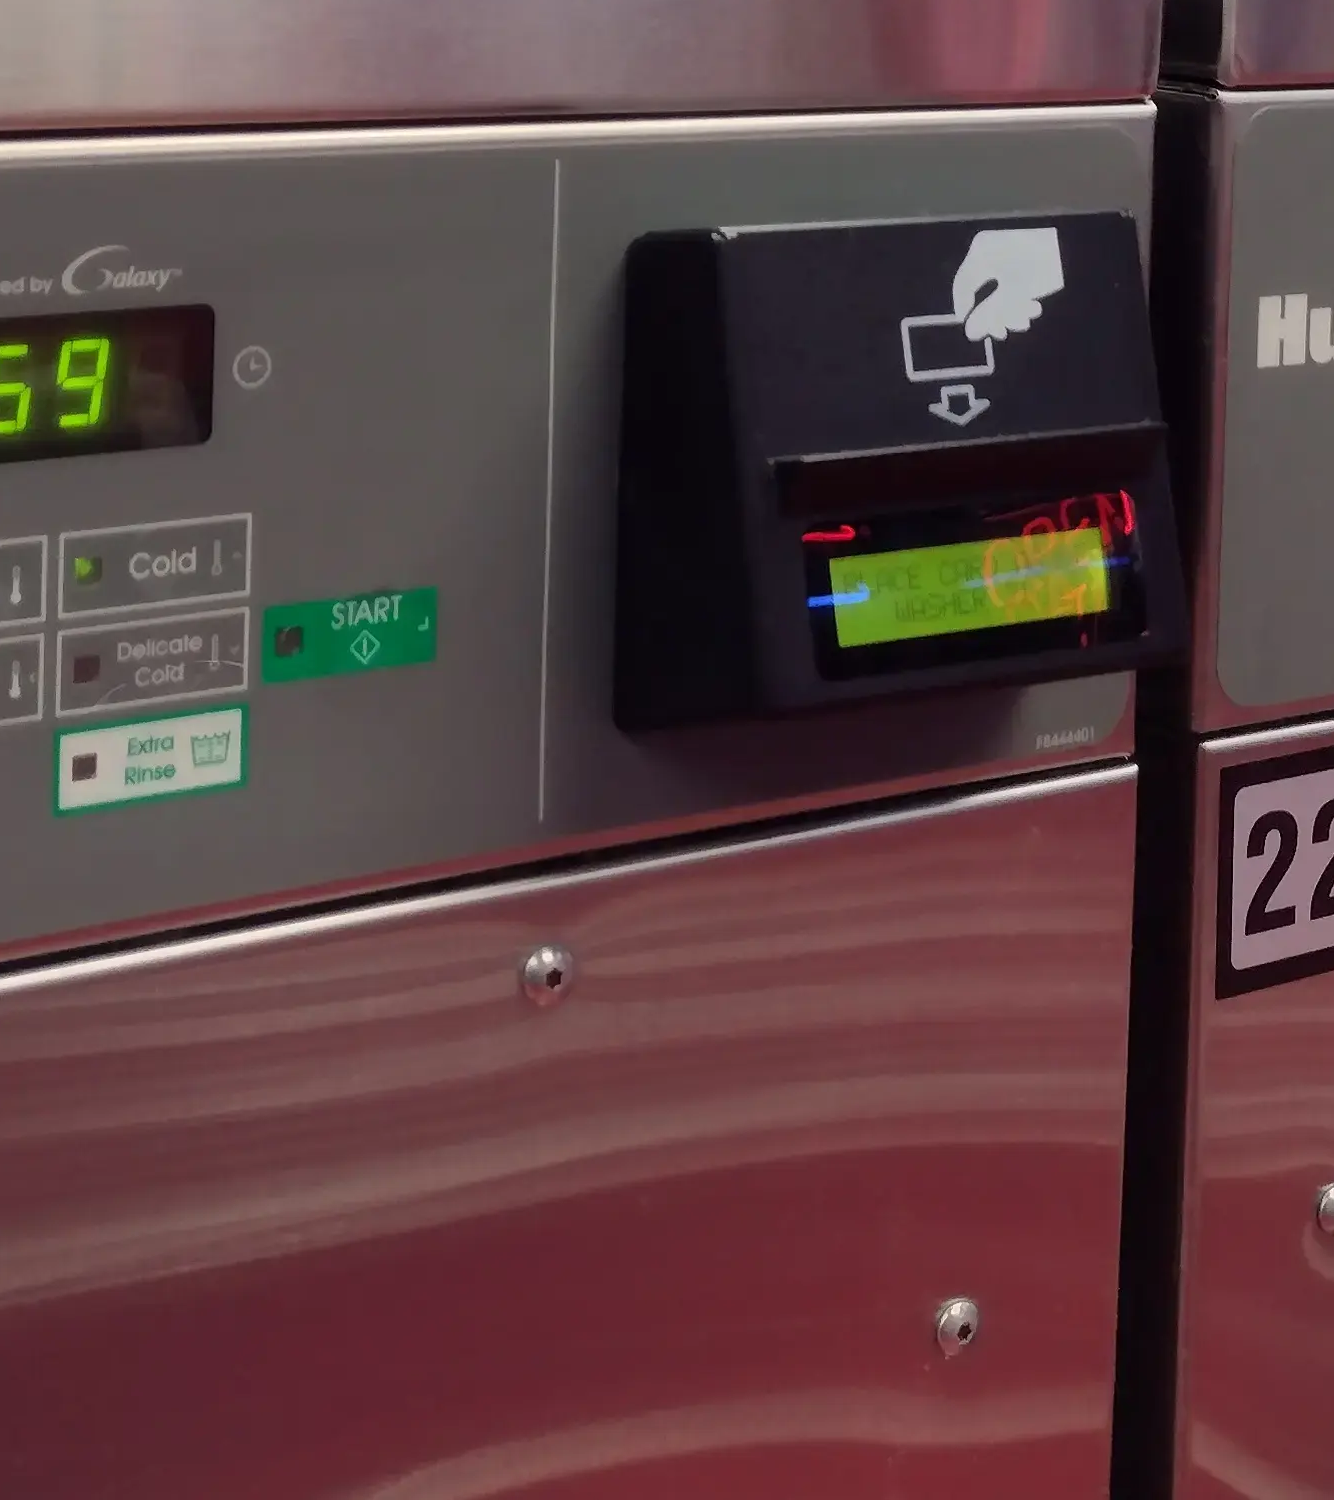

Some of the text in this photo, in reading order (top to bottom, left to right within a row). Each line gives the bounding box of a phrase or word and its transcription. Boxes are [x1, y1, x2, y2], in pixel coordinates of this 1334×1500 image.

[30, 276, 54, 296] by
[129, 546, 197, 581] Cold
[332, 595, 403, 631] START
[117, 635, 203, 663] Delicate
[135, 662, 185, 687] Cold
[126, 734, 175, 758] Extra
[124, 763, 176, 785] Rinse
